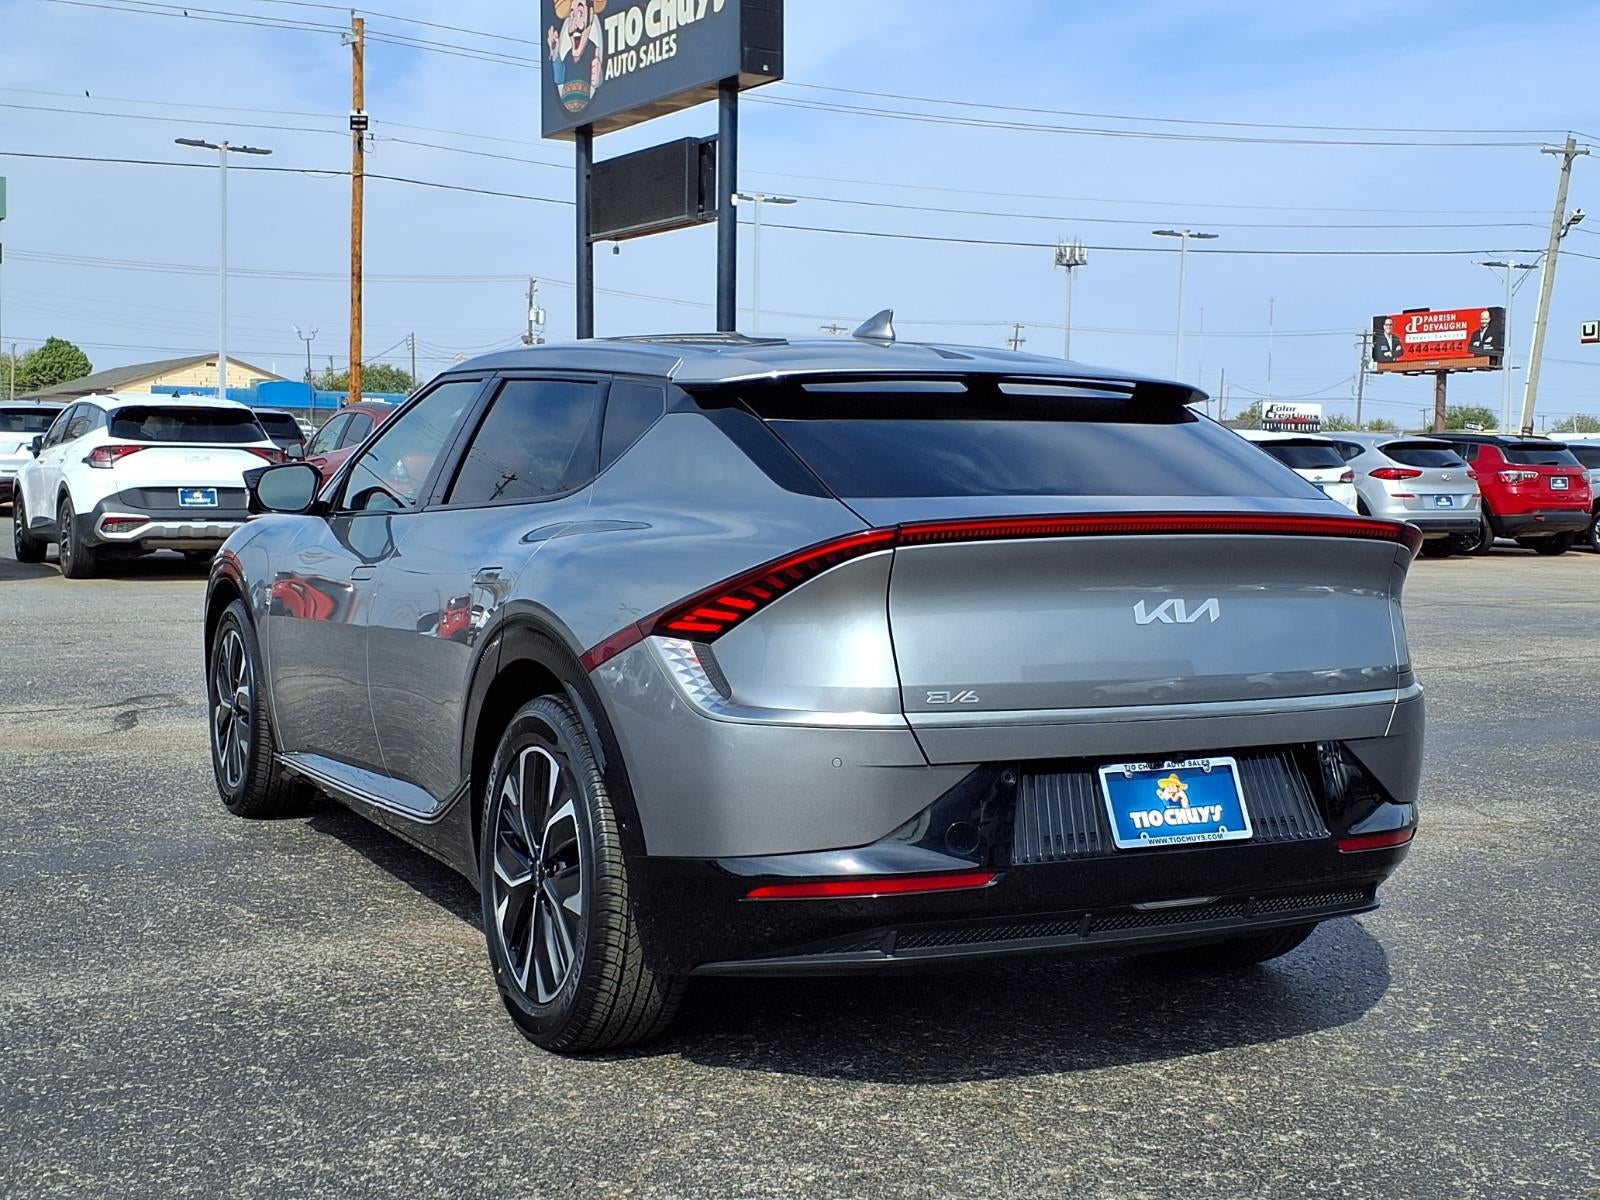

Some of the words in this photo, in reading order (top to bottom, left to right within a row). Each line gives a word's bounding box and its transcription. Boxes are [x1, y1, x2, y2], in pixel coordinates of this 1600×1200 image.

[604, 6, 643, 55] TIO
[605, 54, 637, 81] AUTO
[639, 34, 678, 68] SALES
[1424, 313, 1456, 322] PARRISH
[1423, 321, 1467, 331] DEVAUGHN
[1265, 409, 1319, 420] Creations
[1269, 404, 1297, 413] Color
[1133, 598, 1221, 625] KIA
[926, 690, 980, 704] EV6
[1188, 759, 1210, 767] SALES
[1129, 811, 1164, 829] TIO
[1164, 804, 1223, 827] CHUY'S
[1147, 833, 1224, 845] WWW.TIOCHUYS.COM
